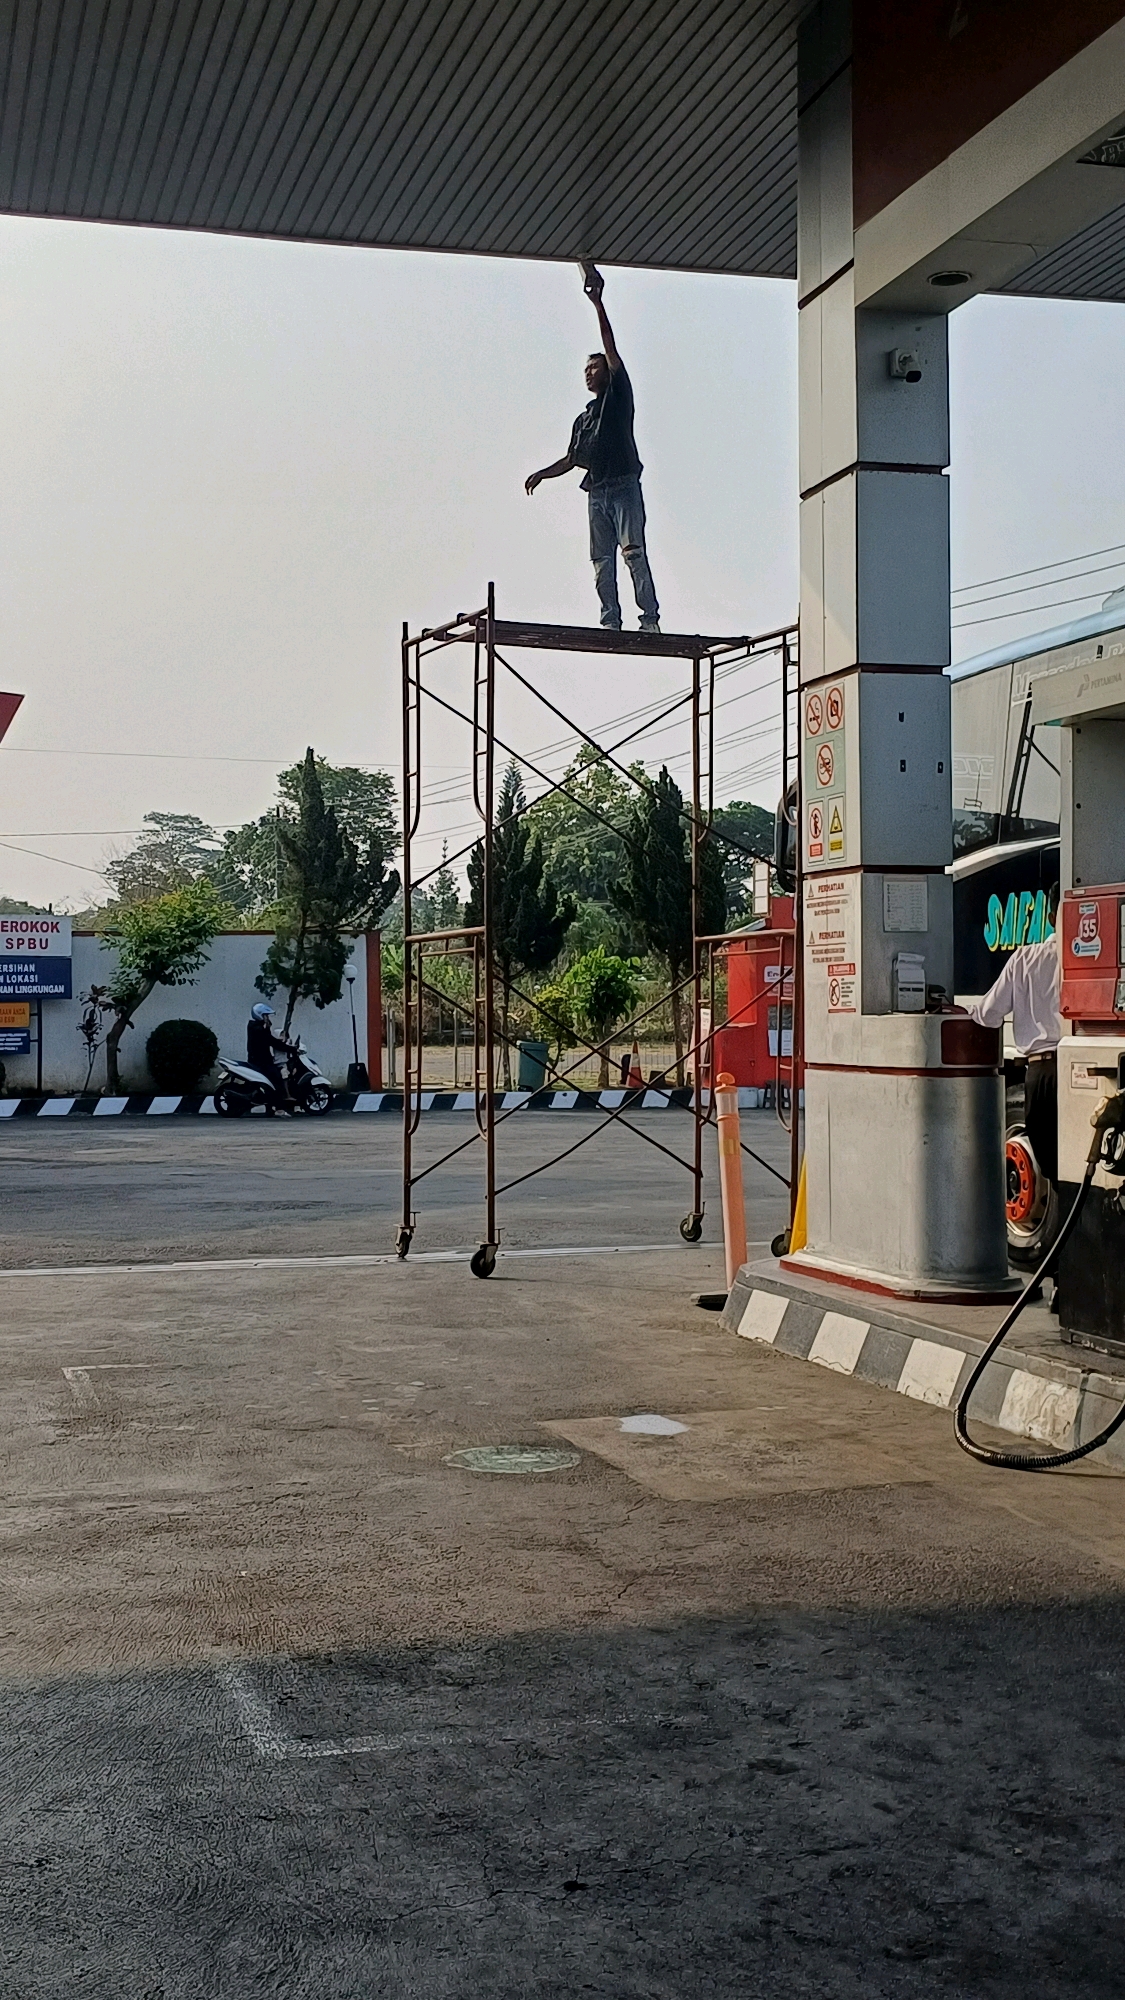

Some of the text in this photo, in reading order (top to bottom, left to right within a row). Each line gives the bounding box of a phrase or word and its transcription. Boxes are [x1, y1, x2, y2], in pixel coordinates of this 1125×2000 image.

[0, 920, 60, 933] EROKOK
[5, 936, 49, 950] SPBU
[6, 974, 38, 984] LOKASI
[15, 984, 65, 994] LINGKUNGAN
